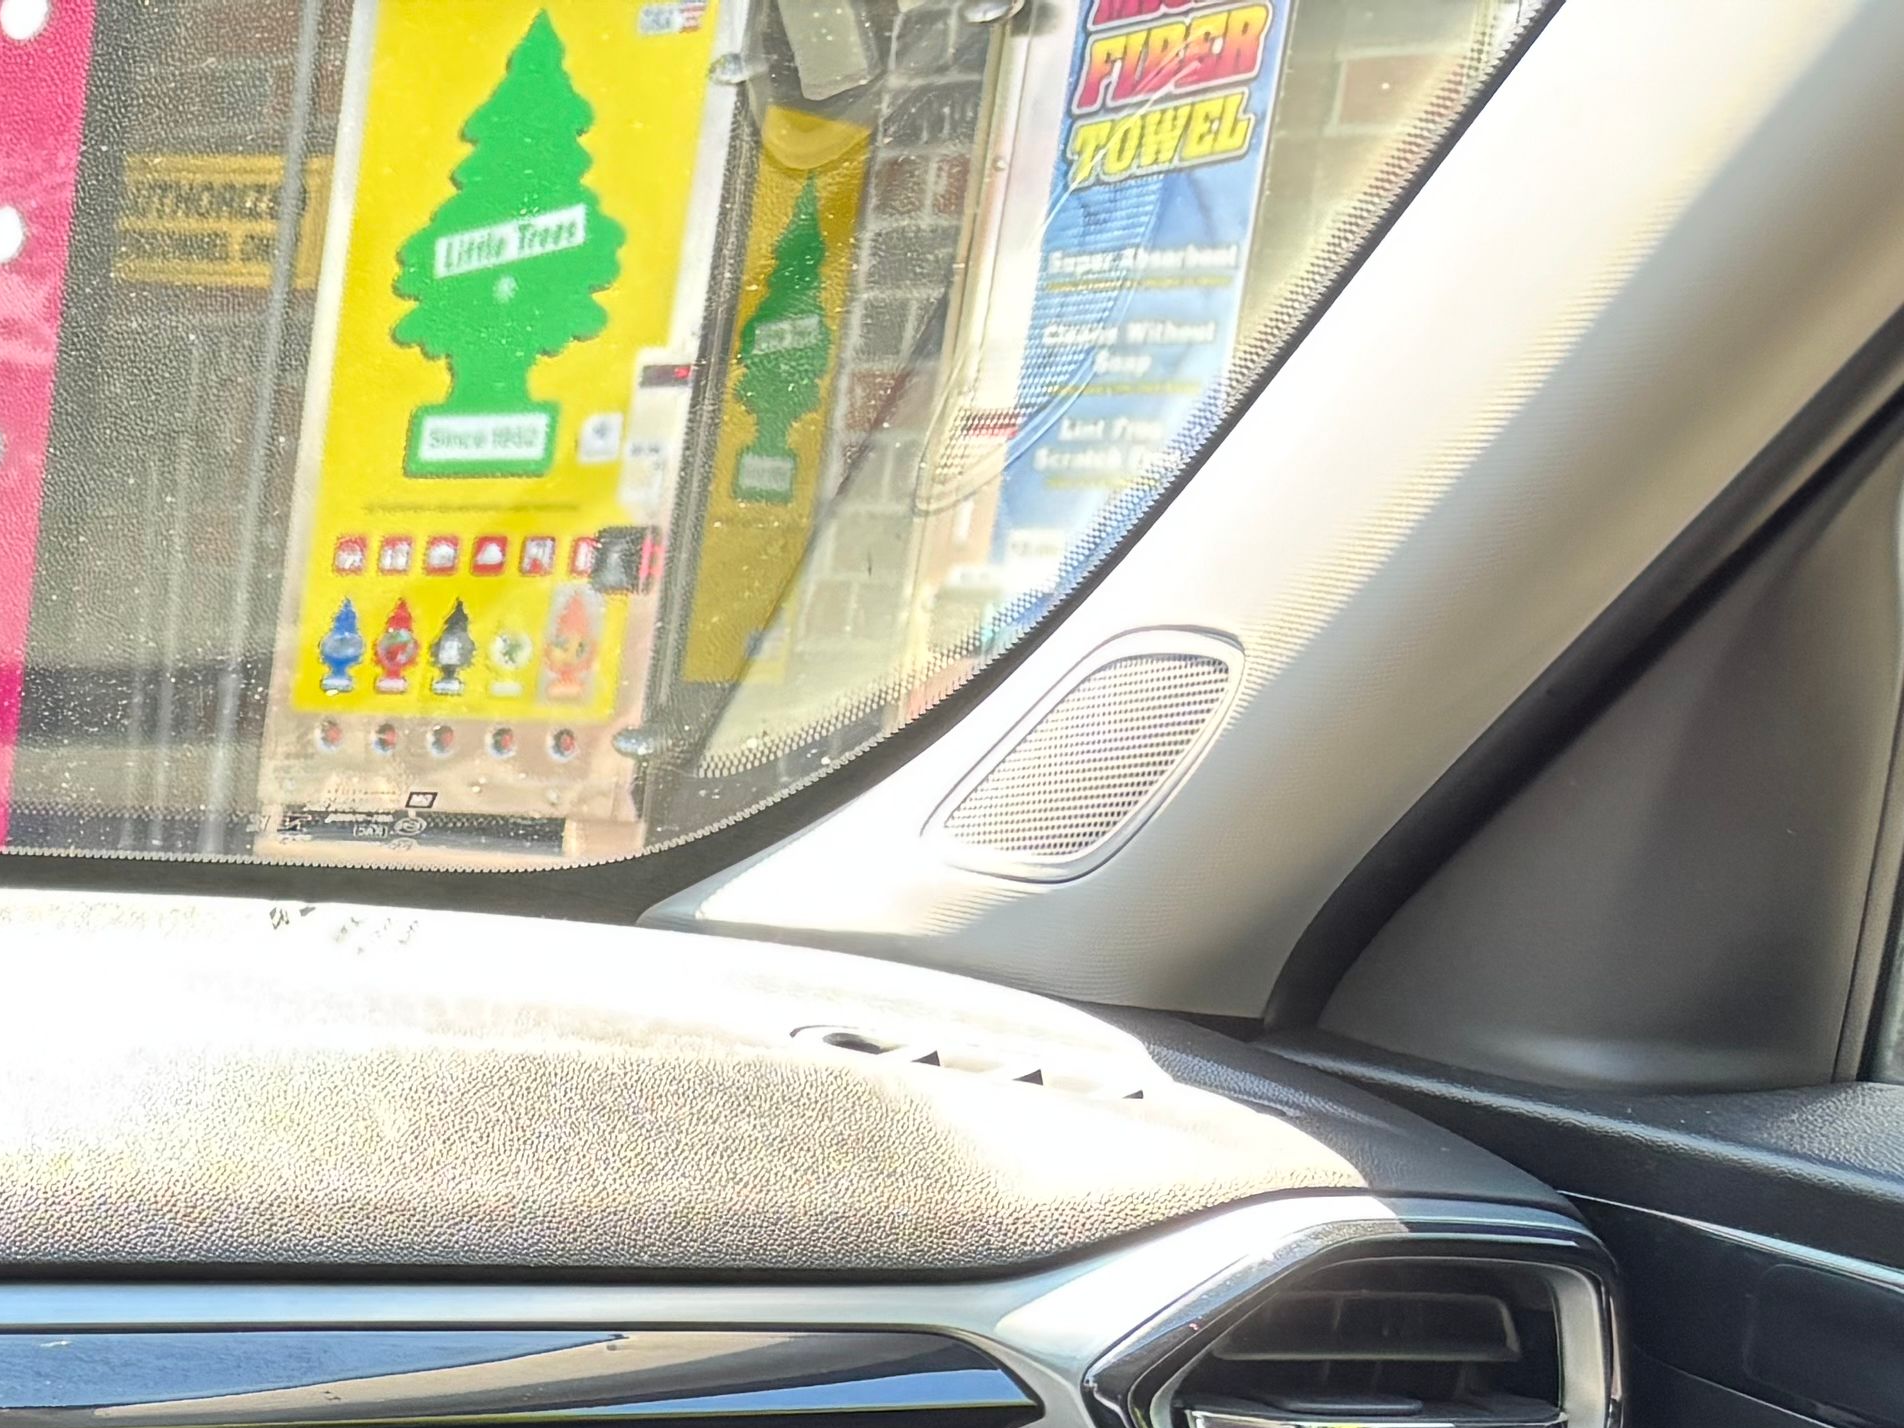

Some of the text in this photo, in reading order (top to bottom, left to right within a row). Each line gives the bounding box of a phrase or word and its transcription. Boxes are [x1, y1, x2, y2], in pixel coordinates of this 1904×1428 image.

[1075, 5, 1269, 110] FIBER
[1073, 92, 1251, 178] TOWEL
[445, 220, 578, 270] Little Trees
